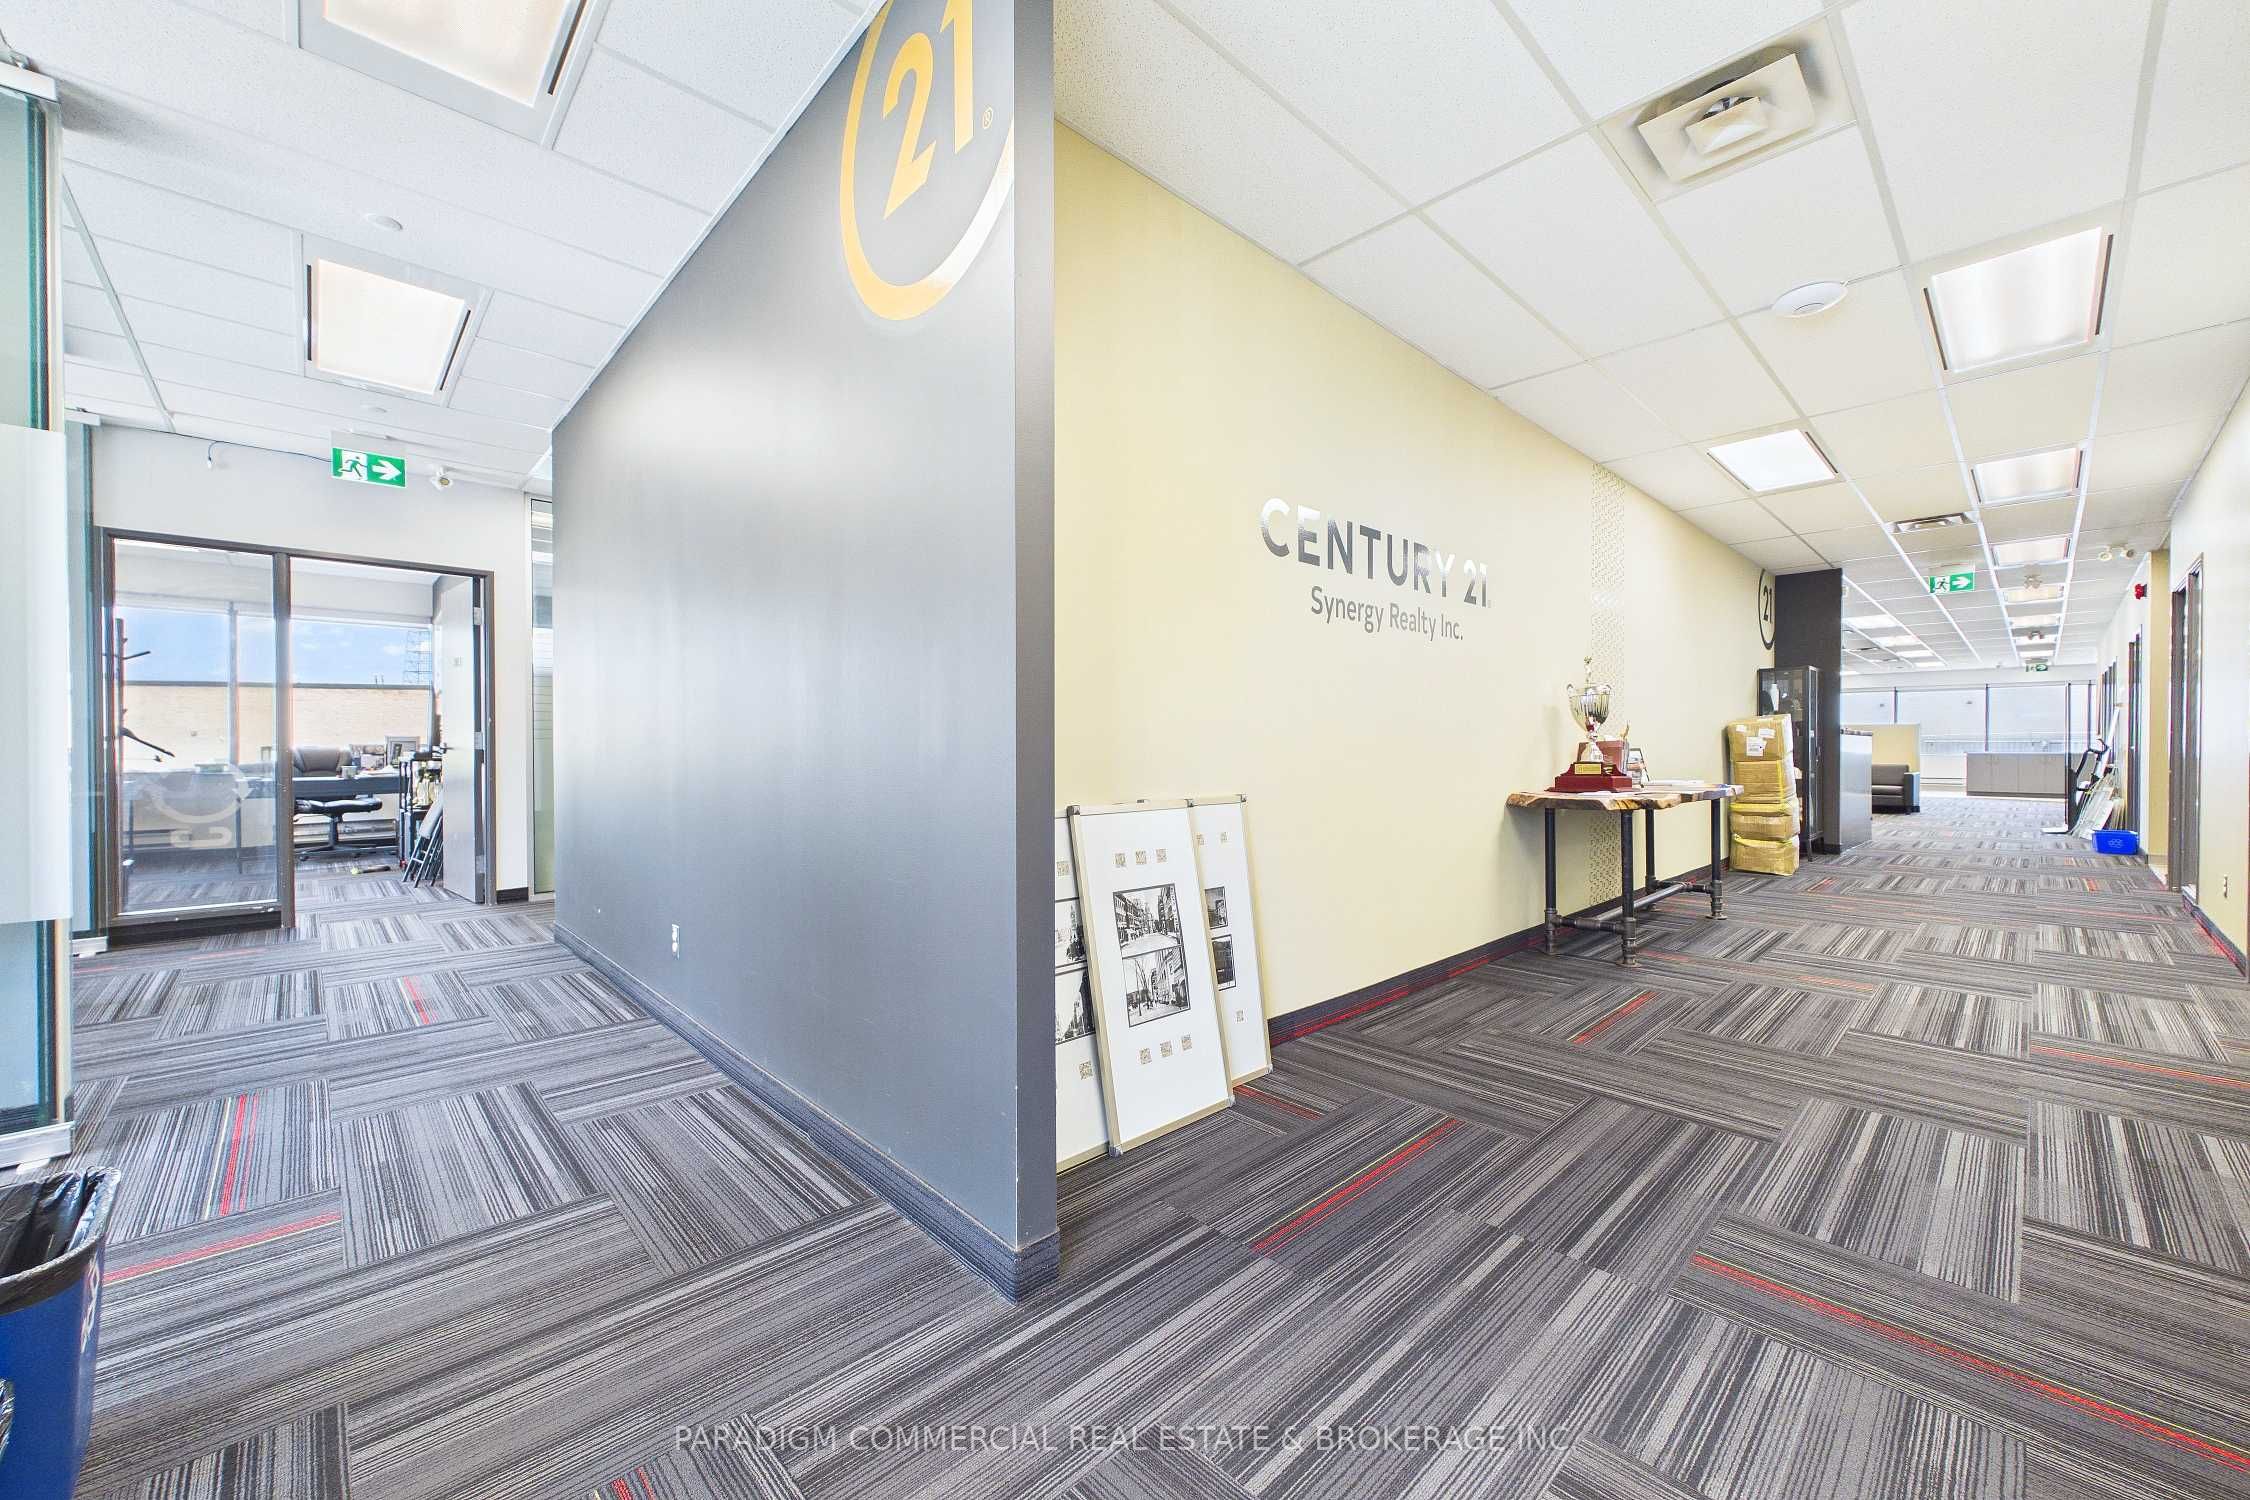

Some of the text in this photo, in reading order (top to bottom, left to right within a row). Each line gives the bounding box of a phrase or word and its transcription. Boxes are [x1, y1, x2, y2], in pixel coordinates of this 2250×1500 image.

[1261, 498, 1455, 598] CENTURY
[1311, 585, 1464, 642] Synergy Realty Inc.
[1763, 585, 1773, 624] 21
